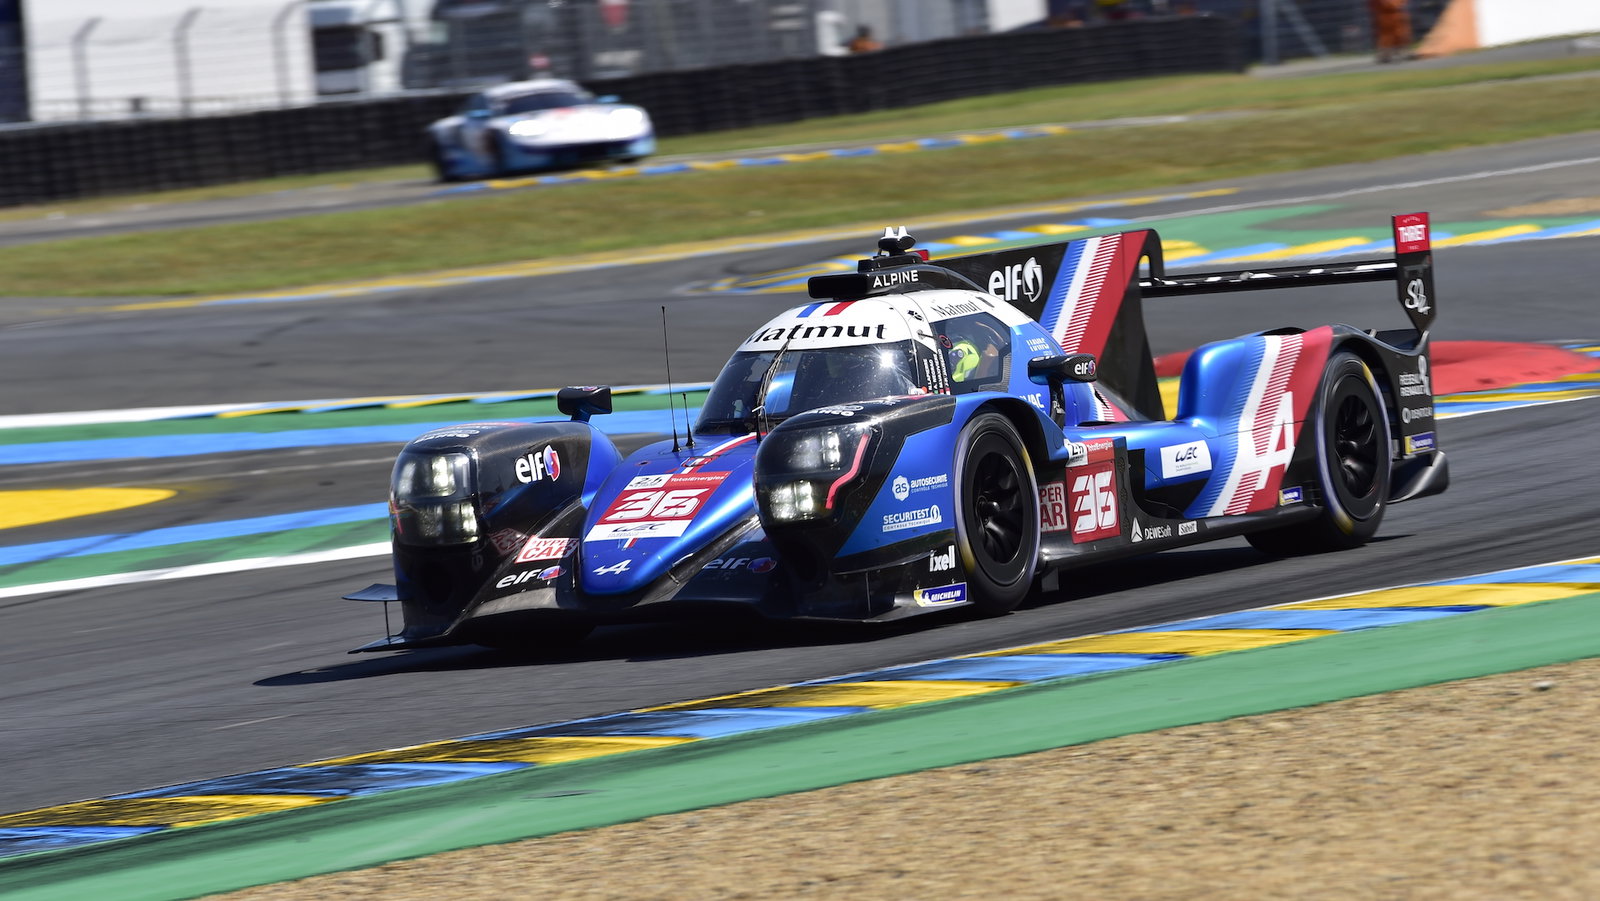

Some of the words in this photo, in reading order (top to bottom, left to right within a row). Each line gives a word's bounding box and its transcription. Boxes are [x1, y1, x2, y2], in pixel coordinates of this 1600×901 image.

[873, 270, 919, 289] ALPINE
[988, 264, 1022, 301] elf
[1074, 362, 1089, 375] elf
[1175, 447, 1198, 463] WEC
[515, 451, 545, 484] elf
[895, 483, 908, 494] as
[1040, 486, 1062, 503] PER
[604, 488, 710, 521] 36
[1072, 470, 1118, 535] 36
[883, 508, 930, 525] SECURITEST
[1040, 502, 1065, 529] AR
[522, 546, 575, 560] CAR
[929, 545, 956, 572] ixell
[702, 558, 750, 569] elf
[496, 569, 542, 589] elf
[931, 590, 962, 601] MICHELIN
